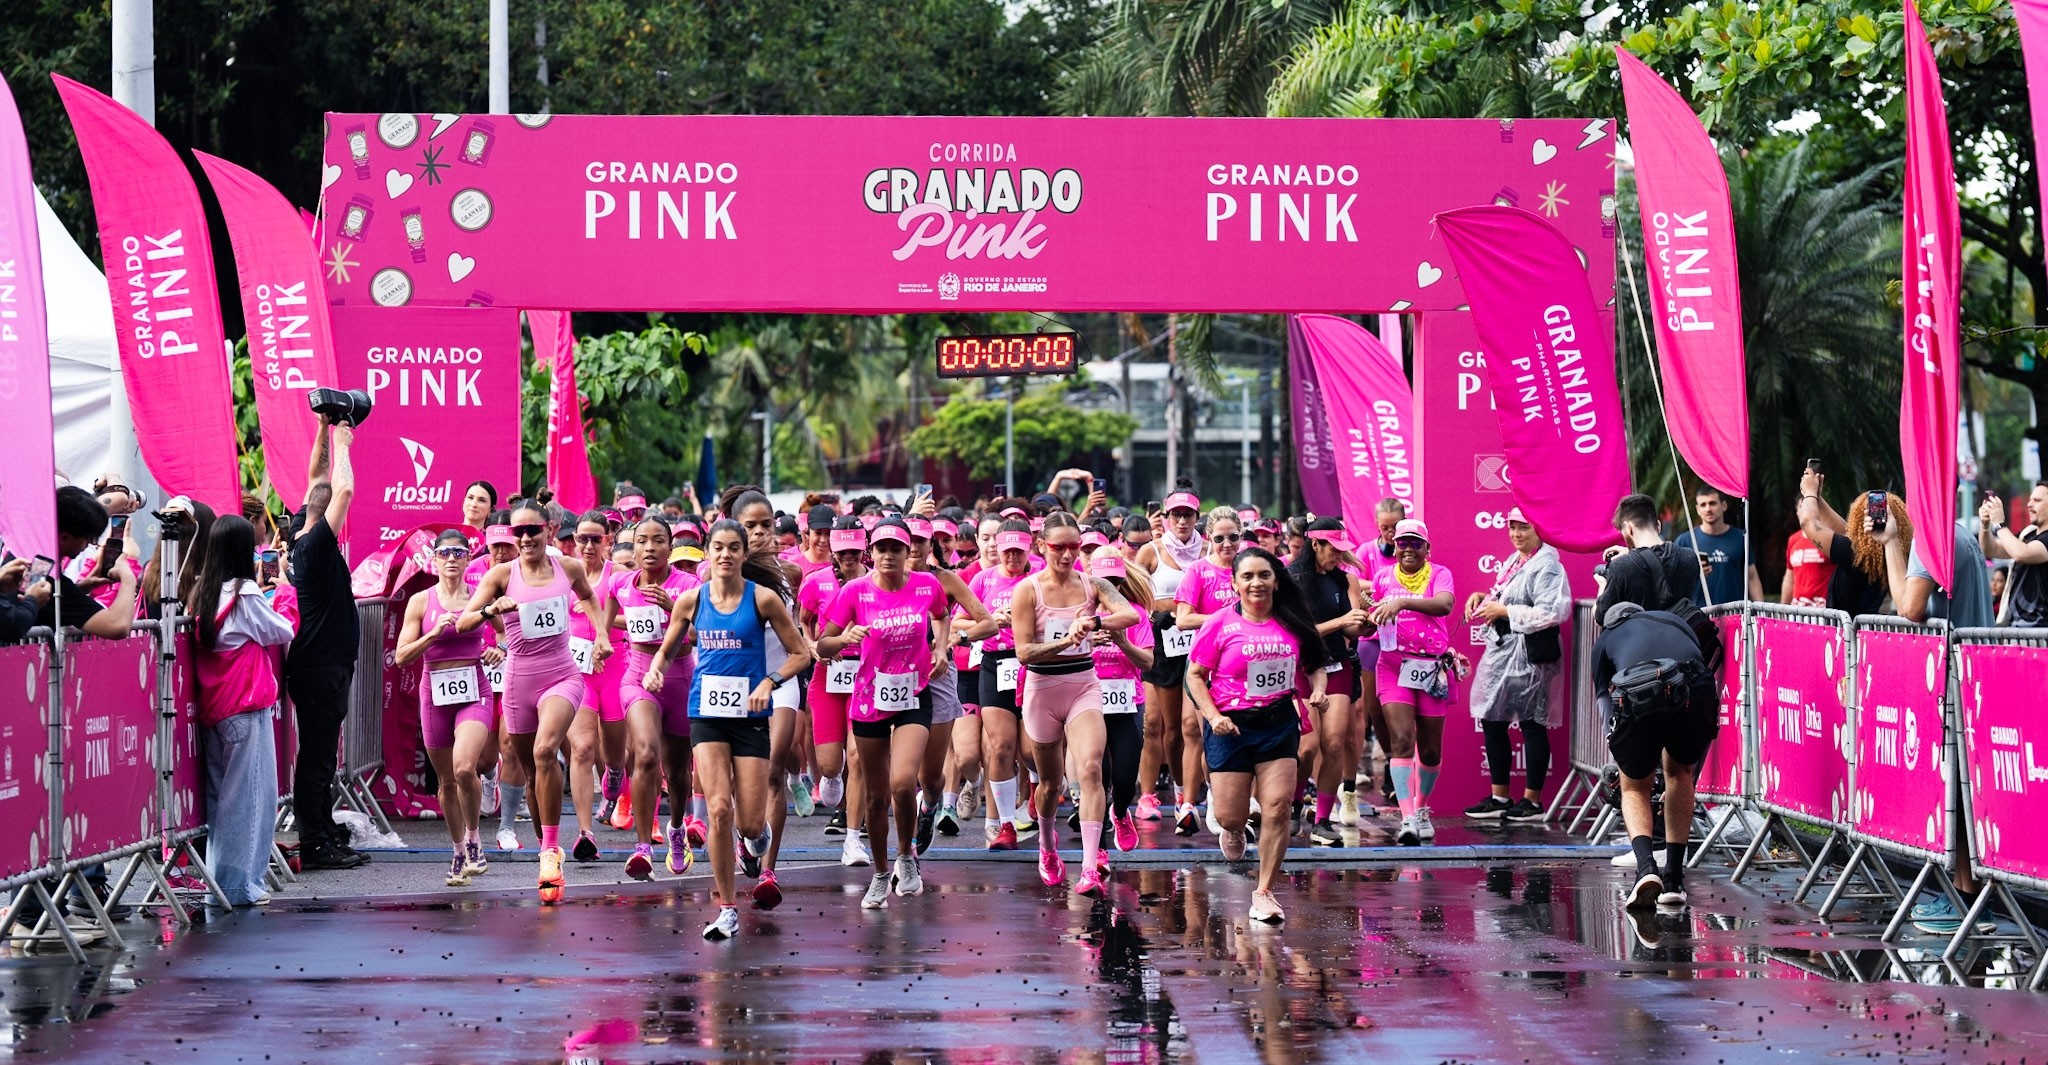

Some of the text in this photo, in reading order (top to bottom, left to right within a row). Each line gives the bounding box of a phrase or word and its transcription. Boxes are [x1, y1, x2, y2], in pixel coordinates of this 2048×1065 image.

[929, 142, 1017, 163] CORRIDA
[585, 161, 738, 184] GRANADO
[1207, 164, 1359, 186] GRANADO
[863, 167, 1083, 214] GRANADO
[585, 190, 738, 240] PINK
[1207, 192, 1359, 242] PINK
[892, 203, 1048, 261] Pink
[1653, 211, 1680, 331] GRANADO
[1673, 210, 1714, 331] PINK
[122, 236, 155, 359] GRANADO
[144, 228, 199, 356] PINK
[964, 283, 1047, 292] RIO DE JANEIRO
[256, 284, 281, 391] GRANADO
[274, 280, 318, 389] PINK
[367, 347, 483, 364] GRANADO
[942, 336, 1071, 369] 00:00:00
[367, 368, 483, 407] PINK
[1511, 356, 1544, 423] PINK
[1543, 304, 1600, 454] GRANADO
[1348, 429, 1371, 478] PINK
[384, 480, 452, 503] riosul
[1475, 511, 1506, 529] C6
[380, 527, 407, 540] Zon
[1214, 590, 1238, 600] GRAN
[534, 612, 556, 628] 48
[629, 619, 654, 633] 269
[872, 613, 922, 629] GRANADO
[698, 630, 727, 639] ELITE
[1169, 634, 1192, 648] 147
[1242, 643, 1291, 655] GRANADO
[439, 680, 468, 697] 169
[1256, 670, 1286, 688] 958
[708, 690, 741, 707] 852
[880, 686, 908, 702] 632
[1102, 691, 1127, 705] 508
[86, 715, 110, 735] GRANADO
[1778, 705, 1801, 744] PINK
[86, 737, 110, 779] PINK
[1876, 726, 1898, 767] PINK
[1992, 749, 2023, 793] PINK
